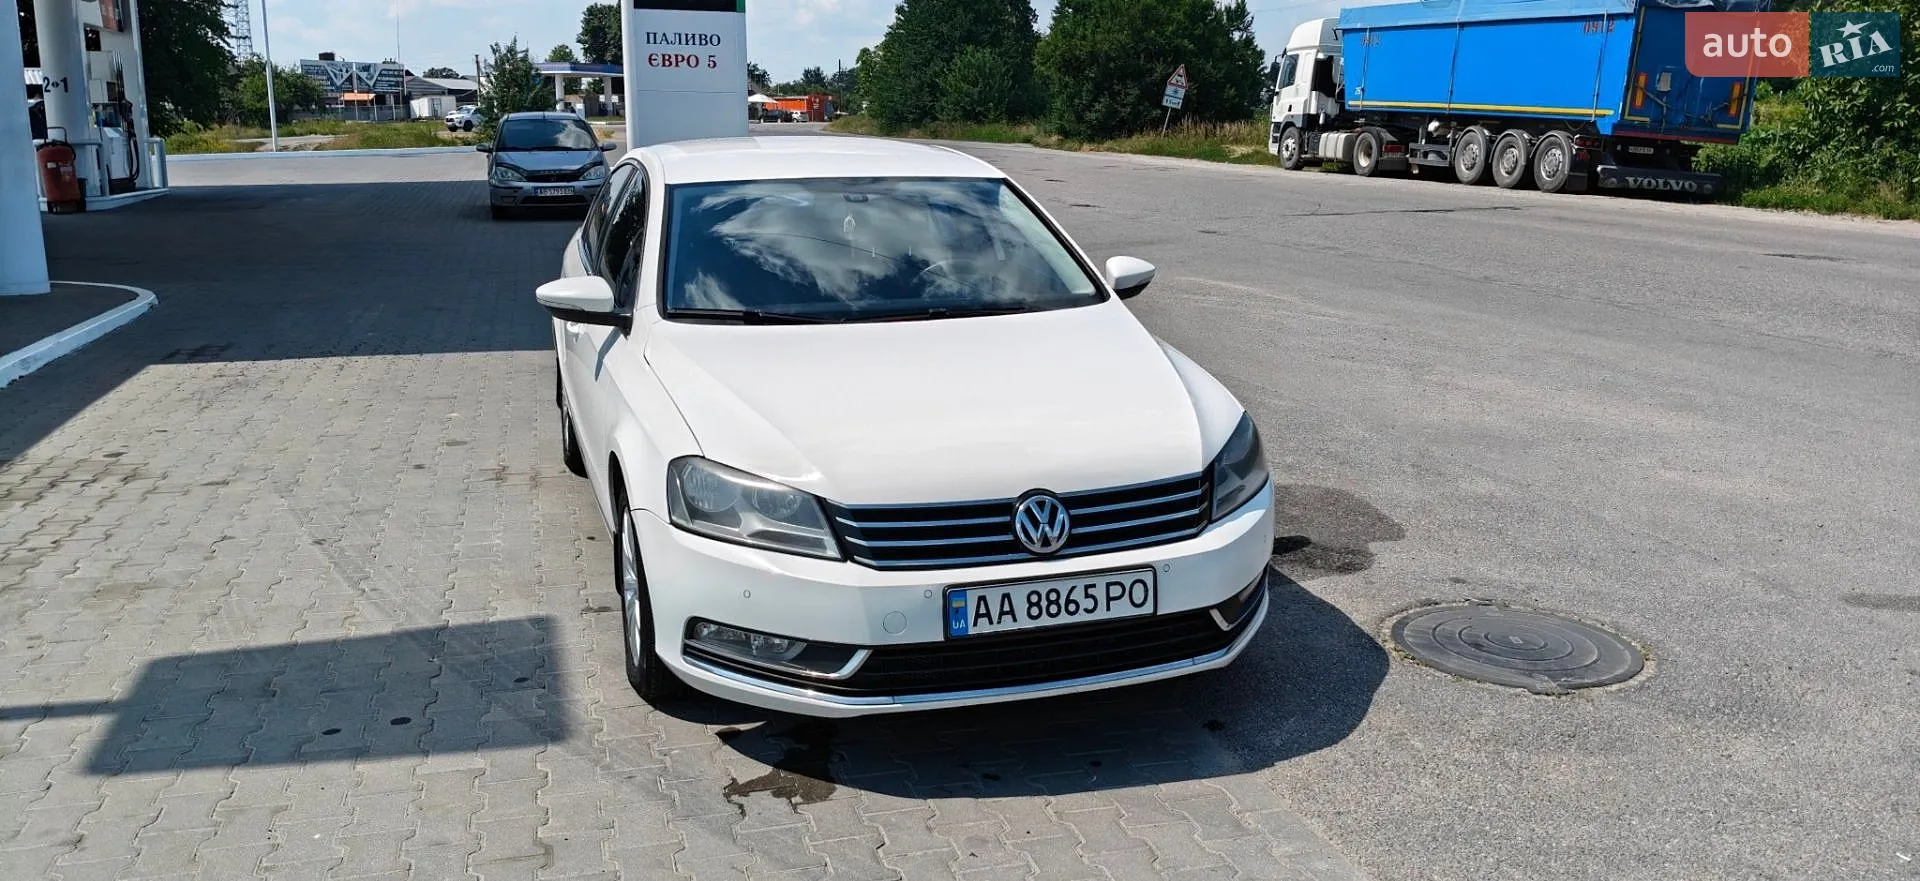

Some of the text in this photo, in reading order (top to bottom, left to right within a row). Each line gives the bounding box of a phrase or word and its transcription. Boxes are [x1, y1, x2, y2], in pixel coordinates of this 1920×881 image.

[646, 32, 721, 46] ПАЛИВО
[648, 53, 717, 69] ЄВРО 5
[1624, 176, 1698, 193] VOLVO
[972, 578, 1150, 628] AA 8865 PO
[952, 620, 967, 630] UA
